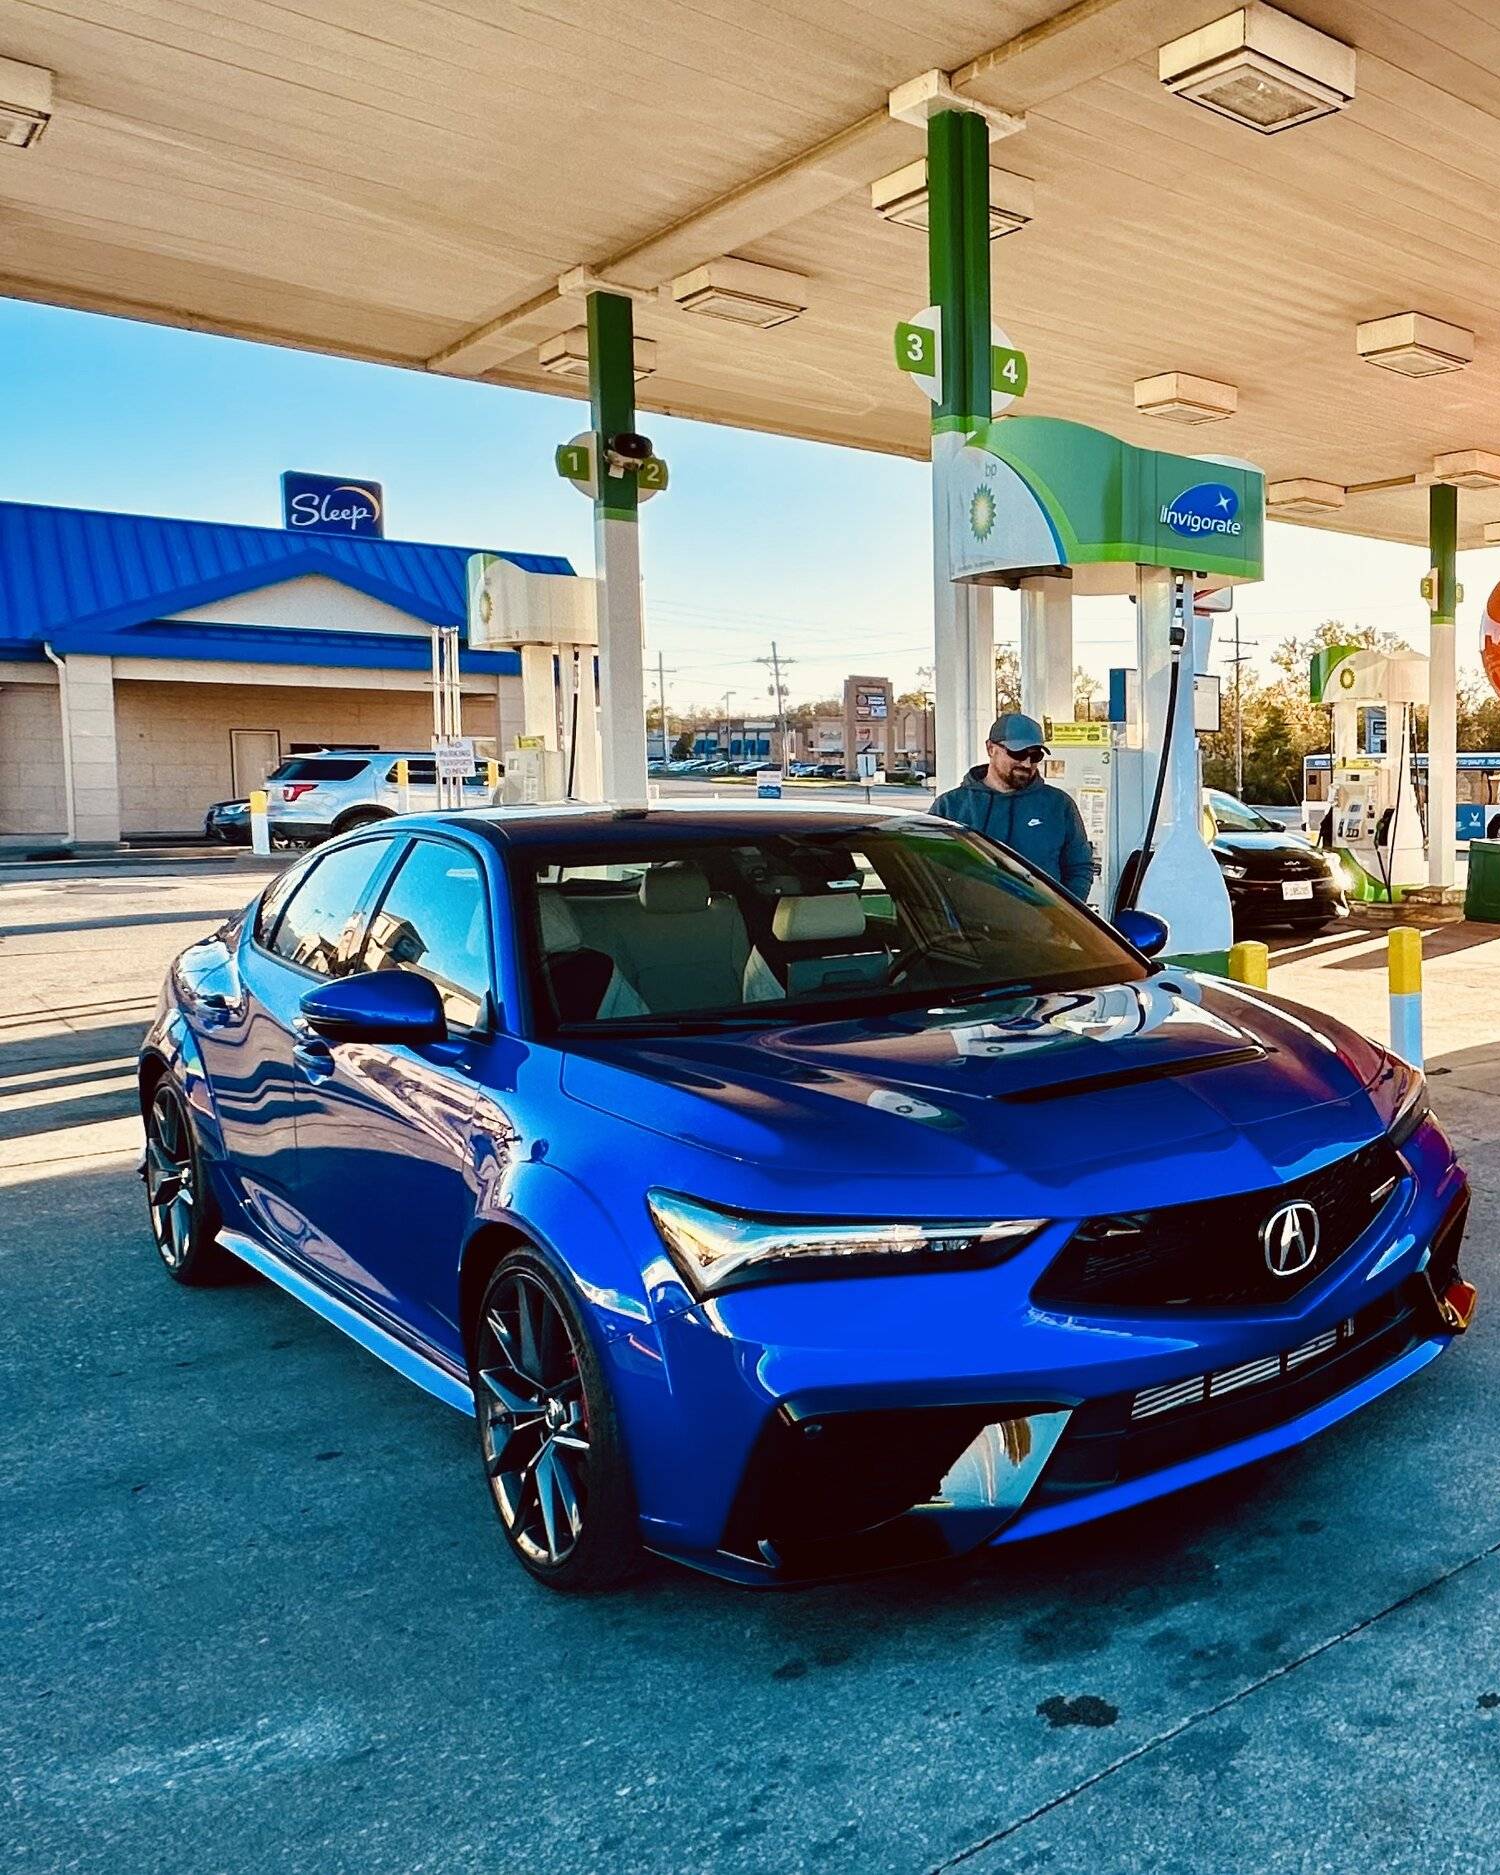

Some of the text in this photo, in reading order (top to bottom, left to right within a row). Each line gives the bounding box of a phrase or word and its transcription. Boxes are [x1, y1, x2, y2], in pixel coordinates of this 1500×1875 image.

[906, 333, 924, 361] 3
[1002, 358, 1019, 384] 4
[567, 452, 578, 471] 1
[646, 463, 660, 482] 2
[985, 463, 998, 479] bp
[291, 493, 373, 531] Sleep
[1160, 505, 1242, 535] Invigorate
[1102, 751, 1110, 764] 3
